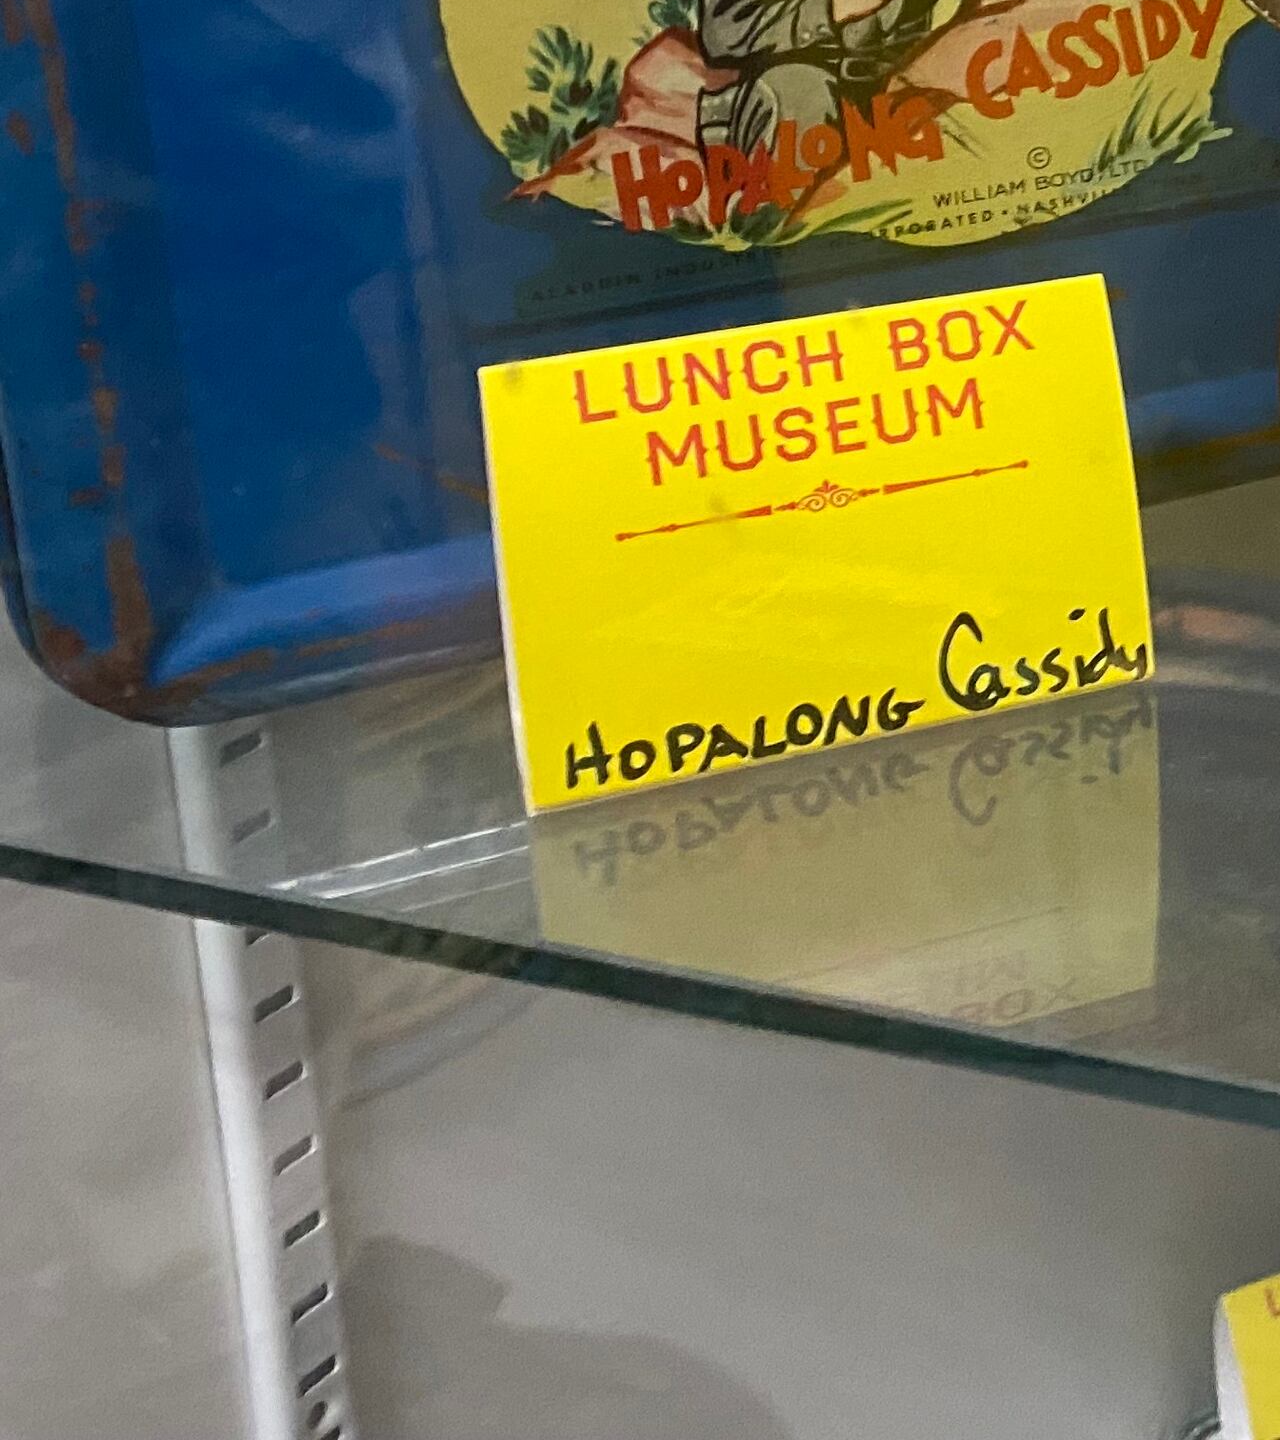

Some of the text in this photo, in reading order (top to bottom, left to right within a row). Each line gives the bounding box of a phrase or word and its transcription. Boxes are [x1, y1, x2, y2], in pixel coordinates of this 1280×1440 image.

[611, 93, 946, 232] HOPALONG
[932, 177, 1028, 208] WILLIAM
[573, 299, 1036, 426] LUNCH BOX
[645, 378, 988, 487] MUSEUM
[564, 607, 1147, 790] HOPALONG Cassidy
